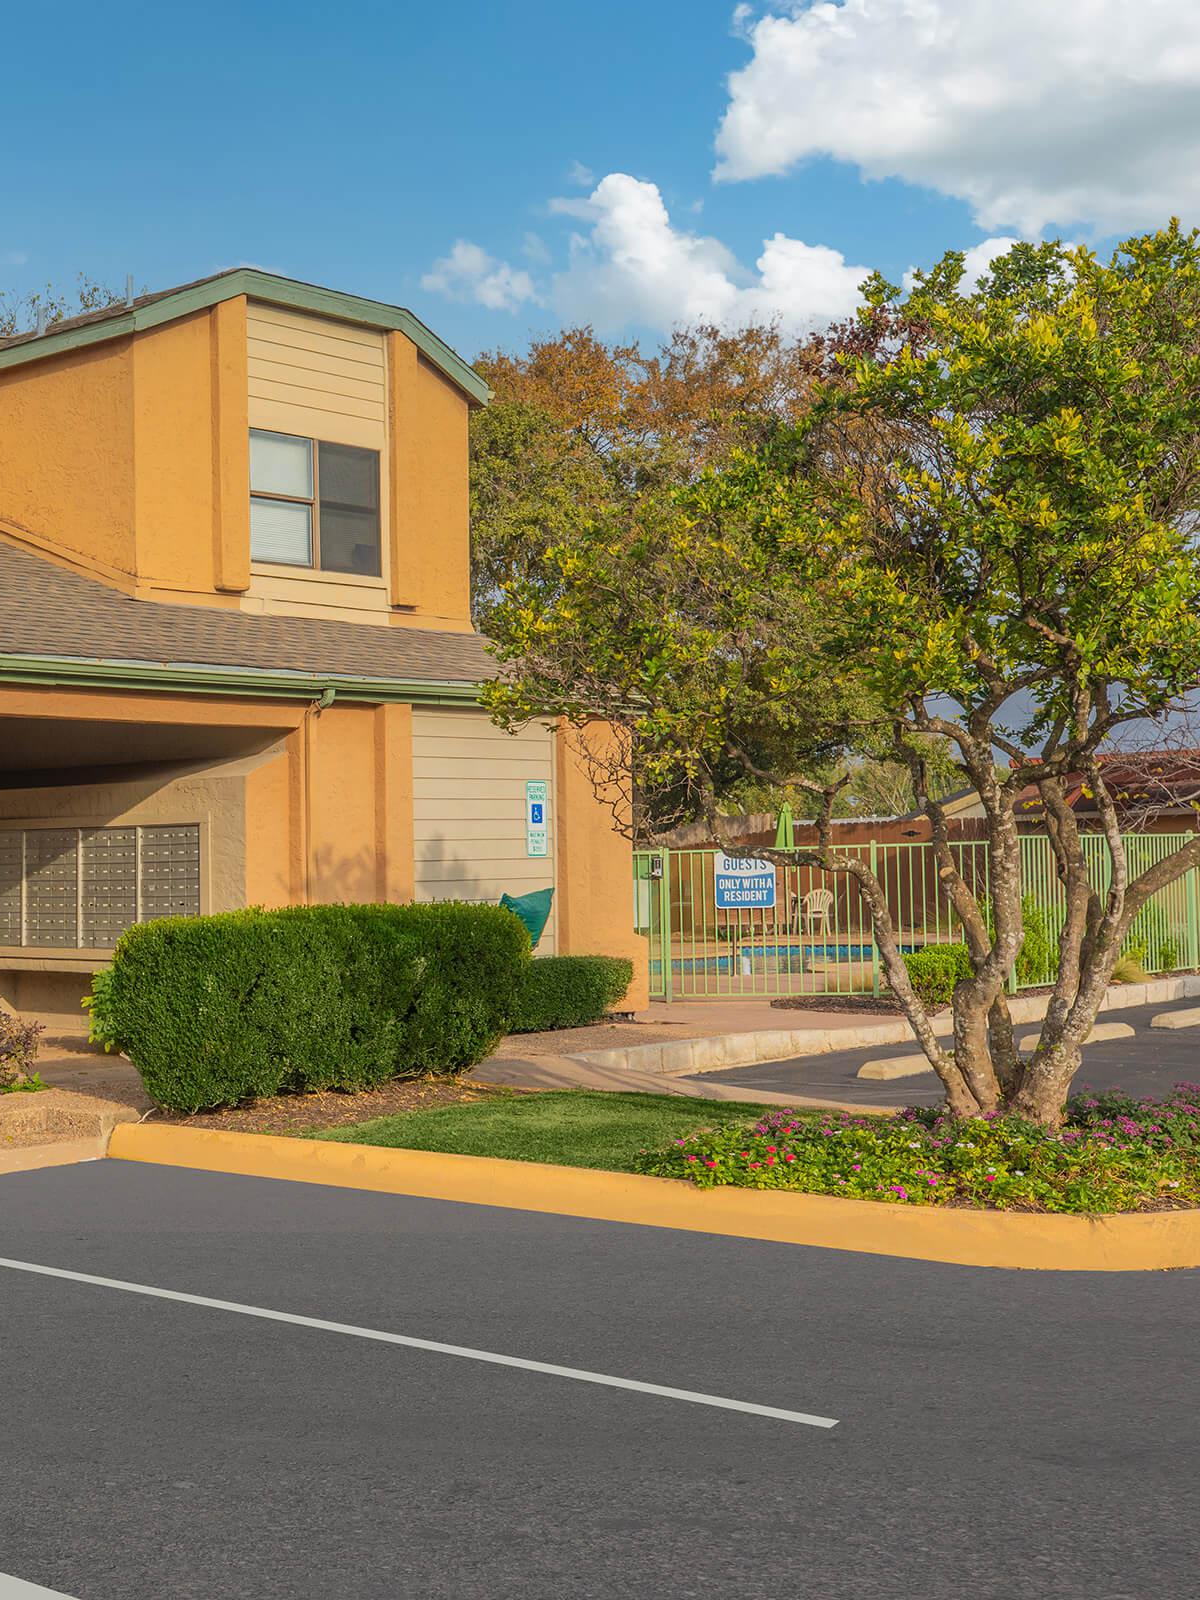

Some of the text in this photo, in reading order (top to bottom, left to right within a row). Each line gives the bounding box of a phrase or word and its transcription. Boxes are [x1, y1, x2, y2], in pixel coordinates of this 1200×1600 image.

[724, 858, 767, 871] GUESTS
[719, 878, 773, 889] ONLY WITH A
[724, 890, 768, 902] RESIDENT
